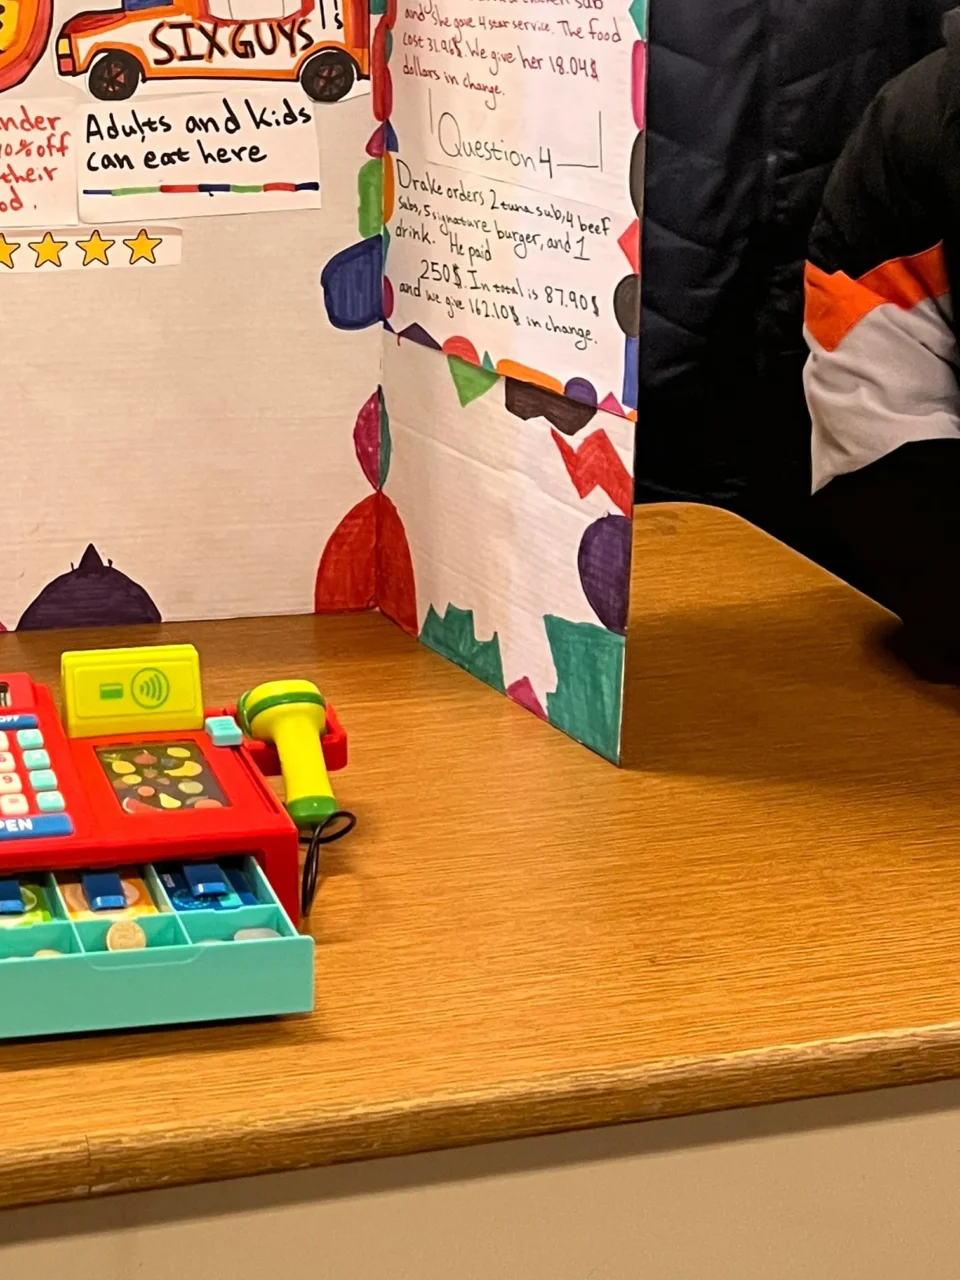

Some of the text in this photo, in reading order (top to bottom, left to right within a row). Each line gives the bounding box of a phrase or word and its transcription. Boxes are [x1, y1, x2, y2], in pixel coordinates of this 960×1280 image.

[589, 17, 622, 43] food
[403, 54, 440, 80] dollars
[517, 45, 544, 69] her
[185, 98, 242, 135] and
[37, 132, 72, 157] off
[86, 140, 268, 171] can eat here
[438, 112, 553, 179] Question 4
[0, 166, 58, 184] their
[396, 159, 485, 205] Drake orders
[579, 217, 611, 236] beef
[396, 219, 491, 266] drink. He paid
[527, 317, 598, 350] in change.
[2, 775, 12, 783] 9
